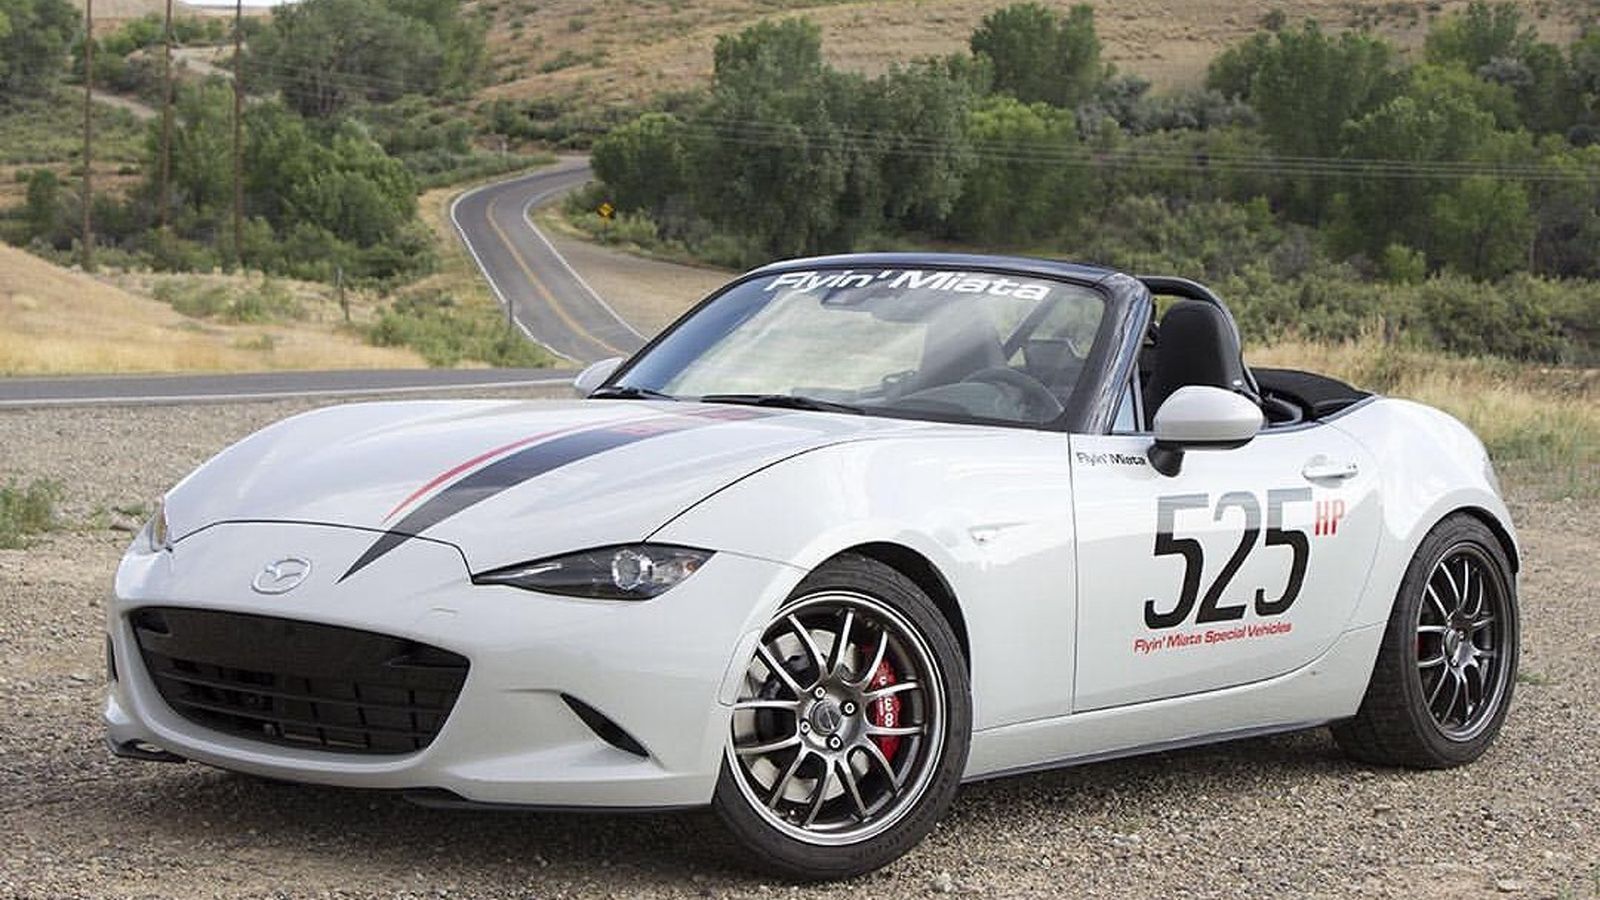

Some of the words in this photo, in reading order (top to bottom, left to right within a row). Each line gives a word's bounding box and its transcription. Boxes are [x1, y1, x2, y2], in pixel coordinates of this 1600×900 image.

[764, 270, 890, 293] Flyin'
[891, 269, 1051, 300] Miata
[1109, 453, 1146, 465] Miata
[1314, 499, 1345, 536] HP
[1144, 487, 1312, 628] 525
[1134, 637, 1166, 654] Flyin'
[1166, 633, 1202, 648] Miata
[1204, 625, 1247, 644] Special
[1248, 621, 1293, 637] Vehicles
